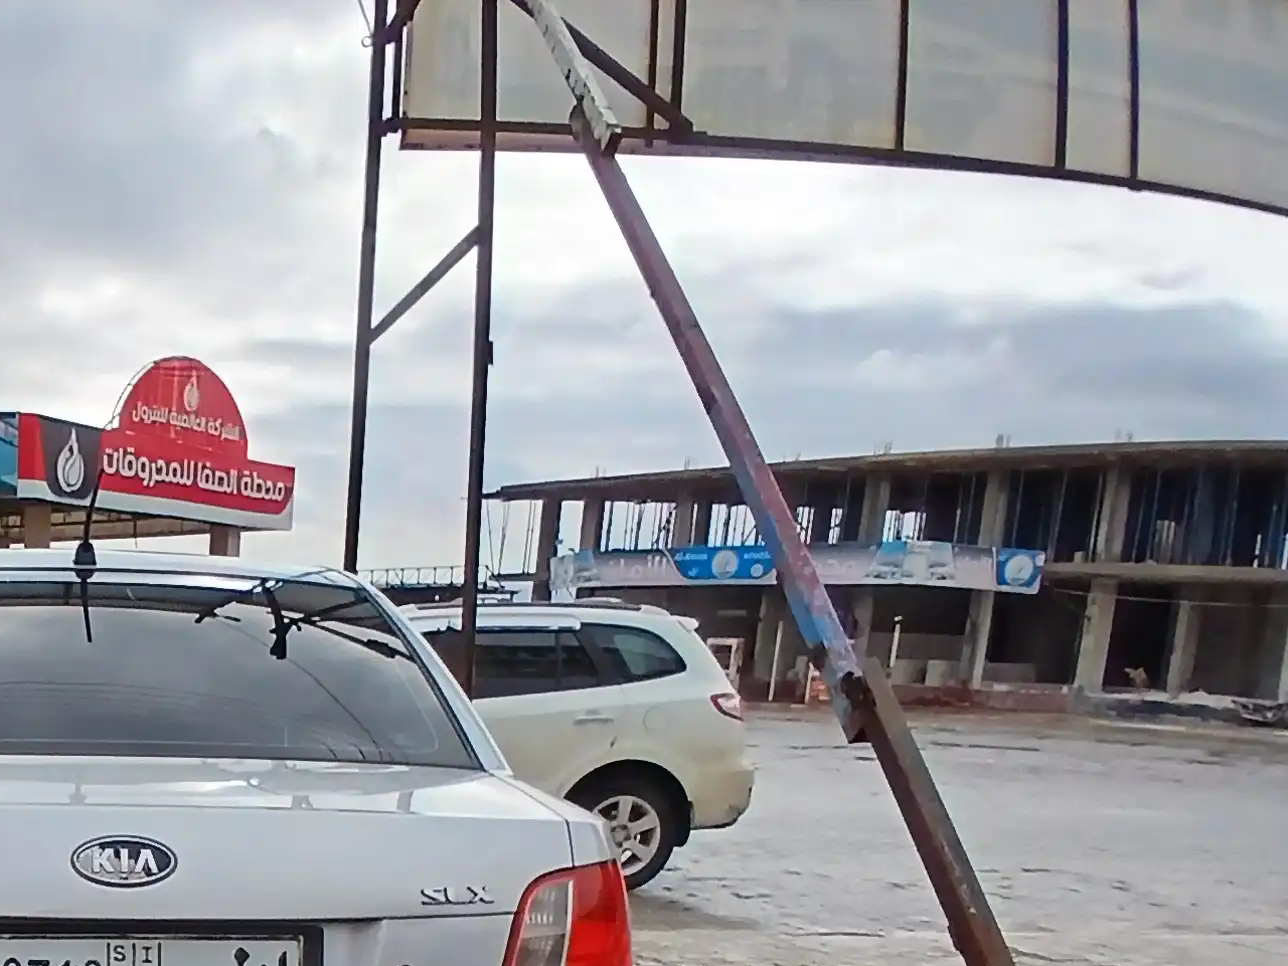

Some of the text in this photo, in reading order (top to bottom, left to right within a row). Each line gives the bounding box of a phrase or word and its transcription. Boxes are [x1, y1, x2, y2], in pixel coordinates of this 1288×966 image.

[103, 447, 285, 501] محطة الصفا للمحروقات
[92, 846, 159, 874] KIA
[420, 885, 495, 905] SLX
